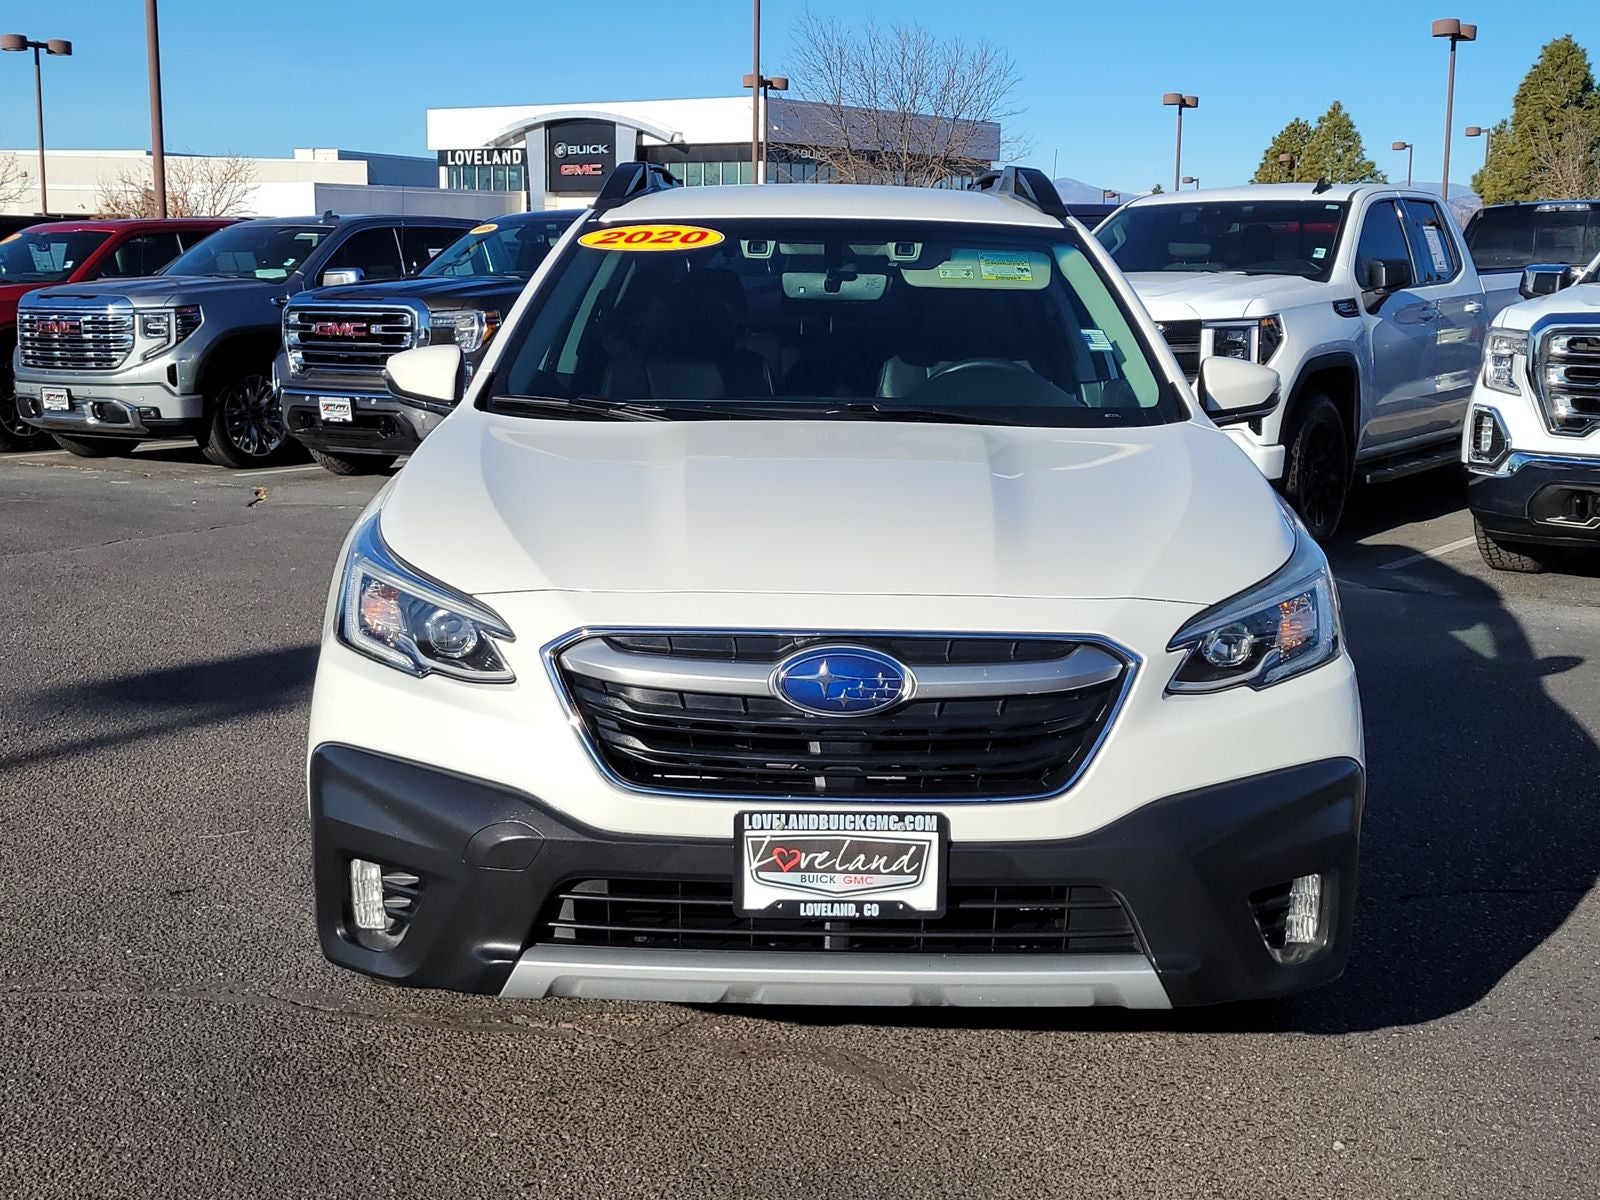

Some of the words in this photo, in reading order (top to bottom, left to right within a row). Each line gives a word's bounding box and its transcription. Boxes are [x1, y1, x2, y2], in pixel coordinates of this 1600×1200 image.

[567, 144, 610, 155] BUICK
[447, 149, 522, 165] LOVELAND
[560, 164, 602, 175] GMC
[593, 231, 709, 244] 2020
[37, 320, 80, 334] GMC
[315, 322, 366, 336] GMC
[744, 813, 937, 831] LOVELANDBUICKGMCCOM
[800, 874, 836, 884] BUICK
[842, 875, 874, 885] GMC
[800, 903, 860, 917] LOVELAND,
[863, 904, 880, 916] CO
